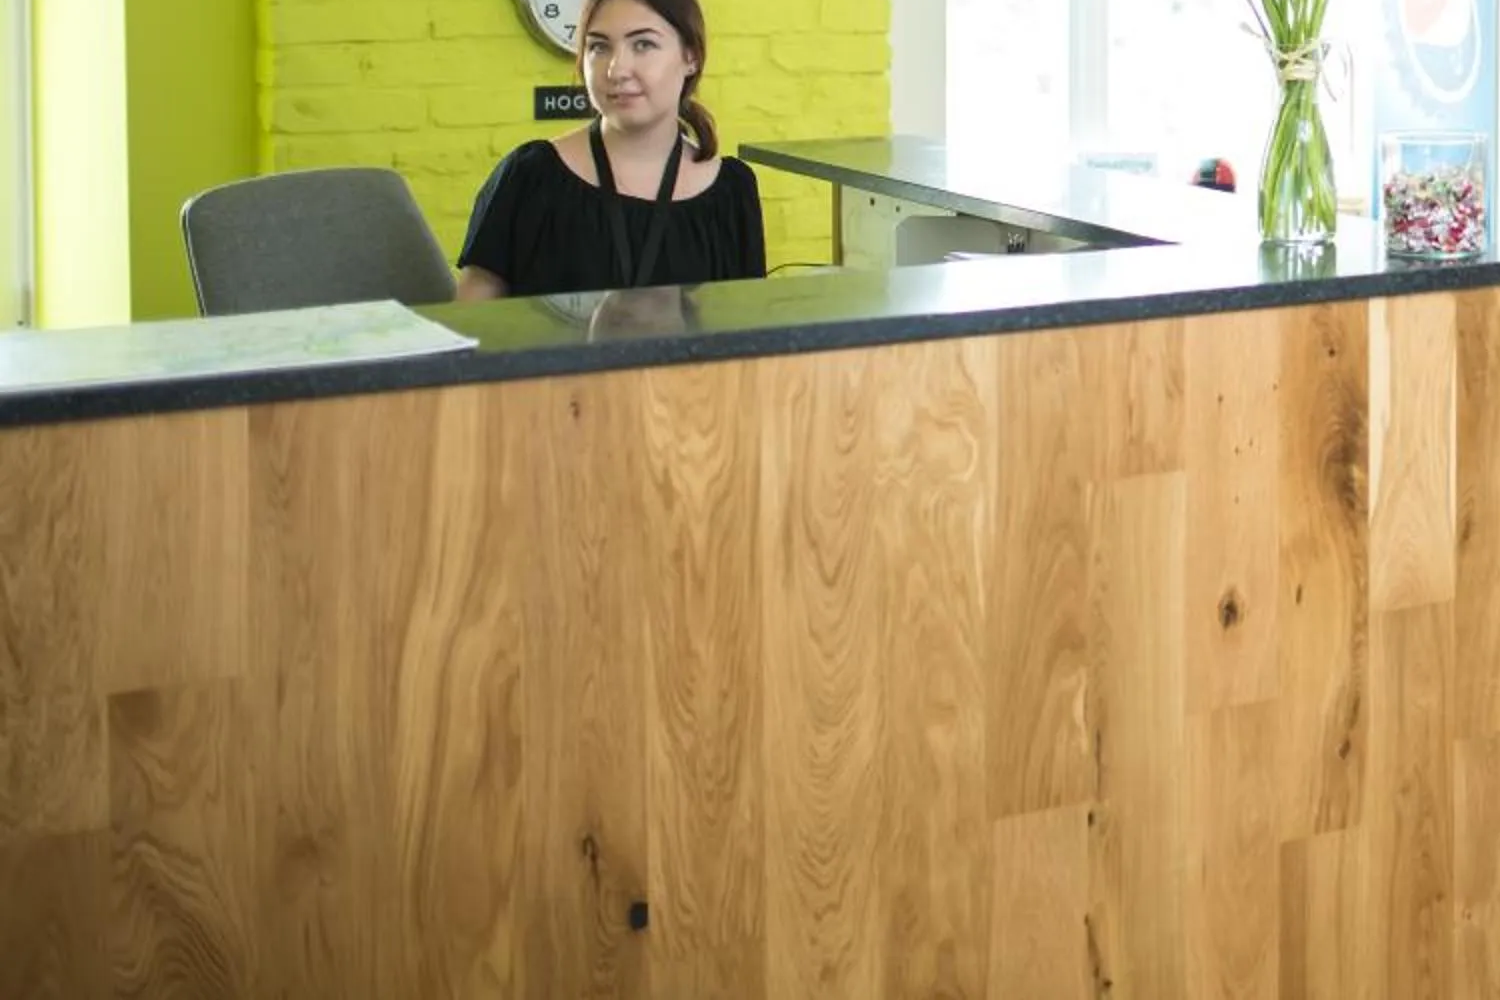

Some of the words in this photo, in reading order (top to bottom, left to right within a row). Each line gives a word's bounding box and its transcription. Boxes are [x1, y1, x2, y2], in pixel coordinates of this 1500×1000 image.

[544, 4, 560, 18] 8
[564, 24, 577, 40] 7
[544, 96, 588, 111] HOG
